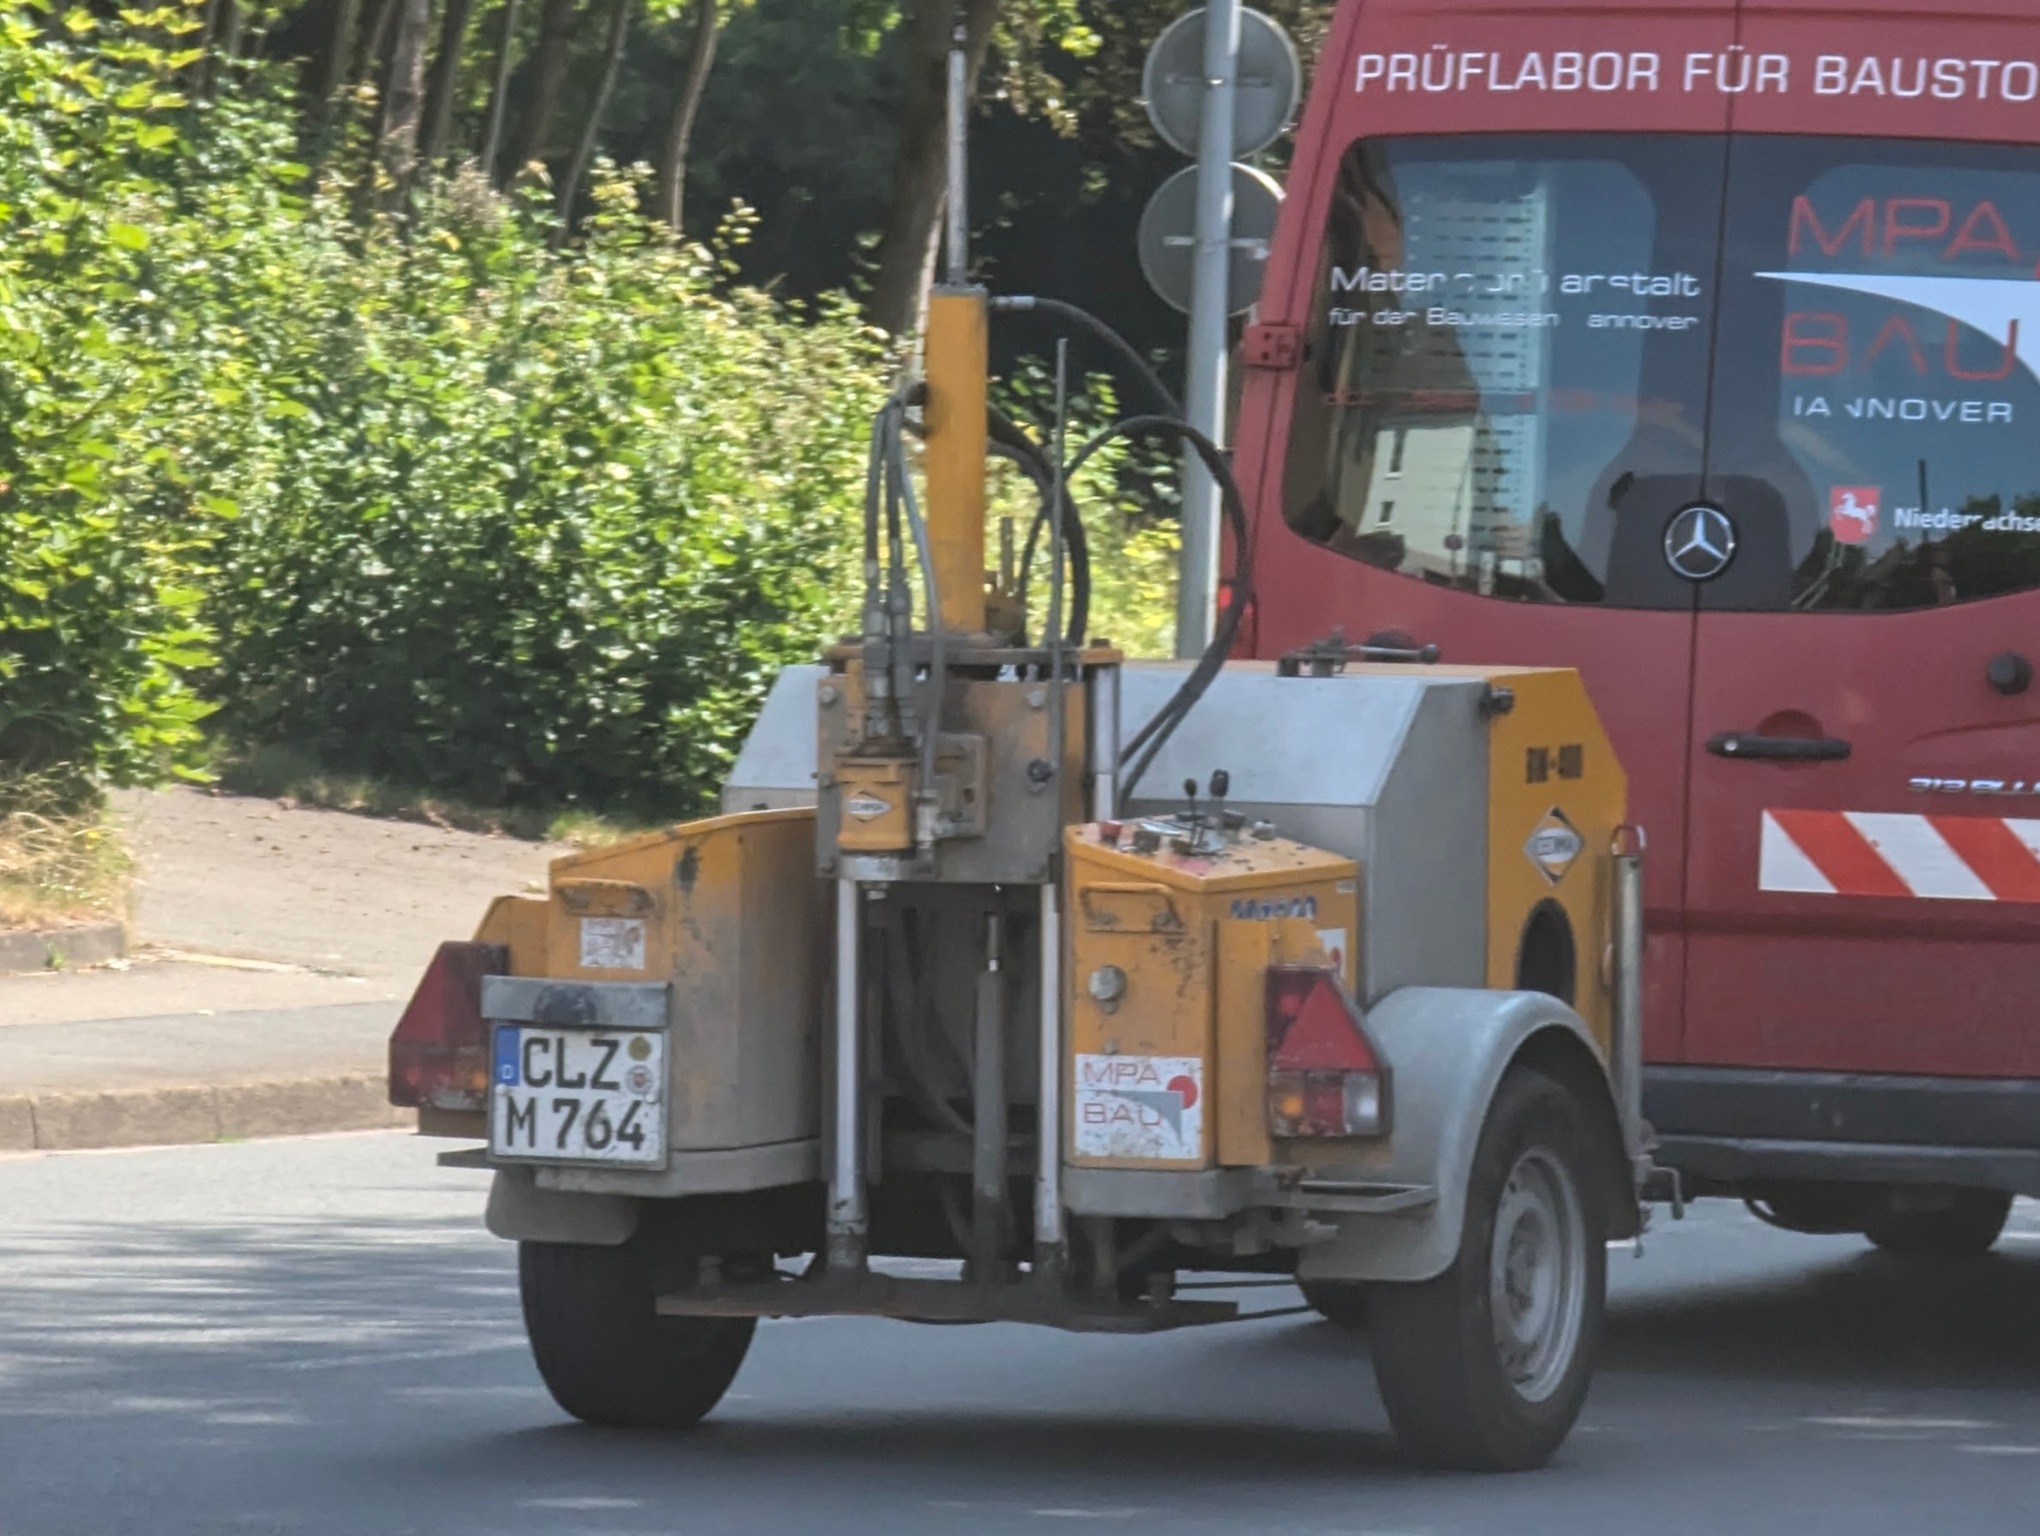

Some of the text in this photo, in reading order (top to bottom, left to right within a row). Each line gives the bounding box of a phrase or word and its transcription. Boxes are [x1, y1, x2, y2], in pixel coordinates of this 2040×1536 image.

[1355, 44, 2039, 101] PRÜFLABOR FÜR BAUSTO
[1788, 195, 2020, 262] MPA
[1328, 307, 1367, 326] für
[1586, 313, 1699, 330] annover
[1779, 310, 2020, 380] BAU
[522, 1036, 620, 1090] CLZ
[1083, 1061, 1161, 1086] MPA
[505, 1097, 646, 1151] M 764
[1083, 1102, 1163, 1127] BAU
